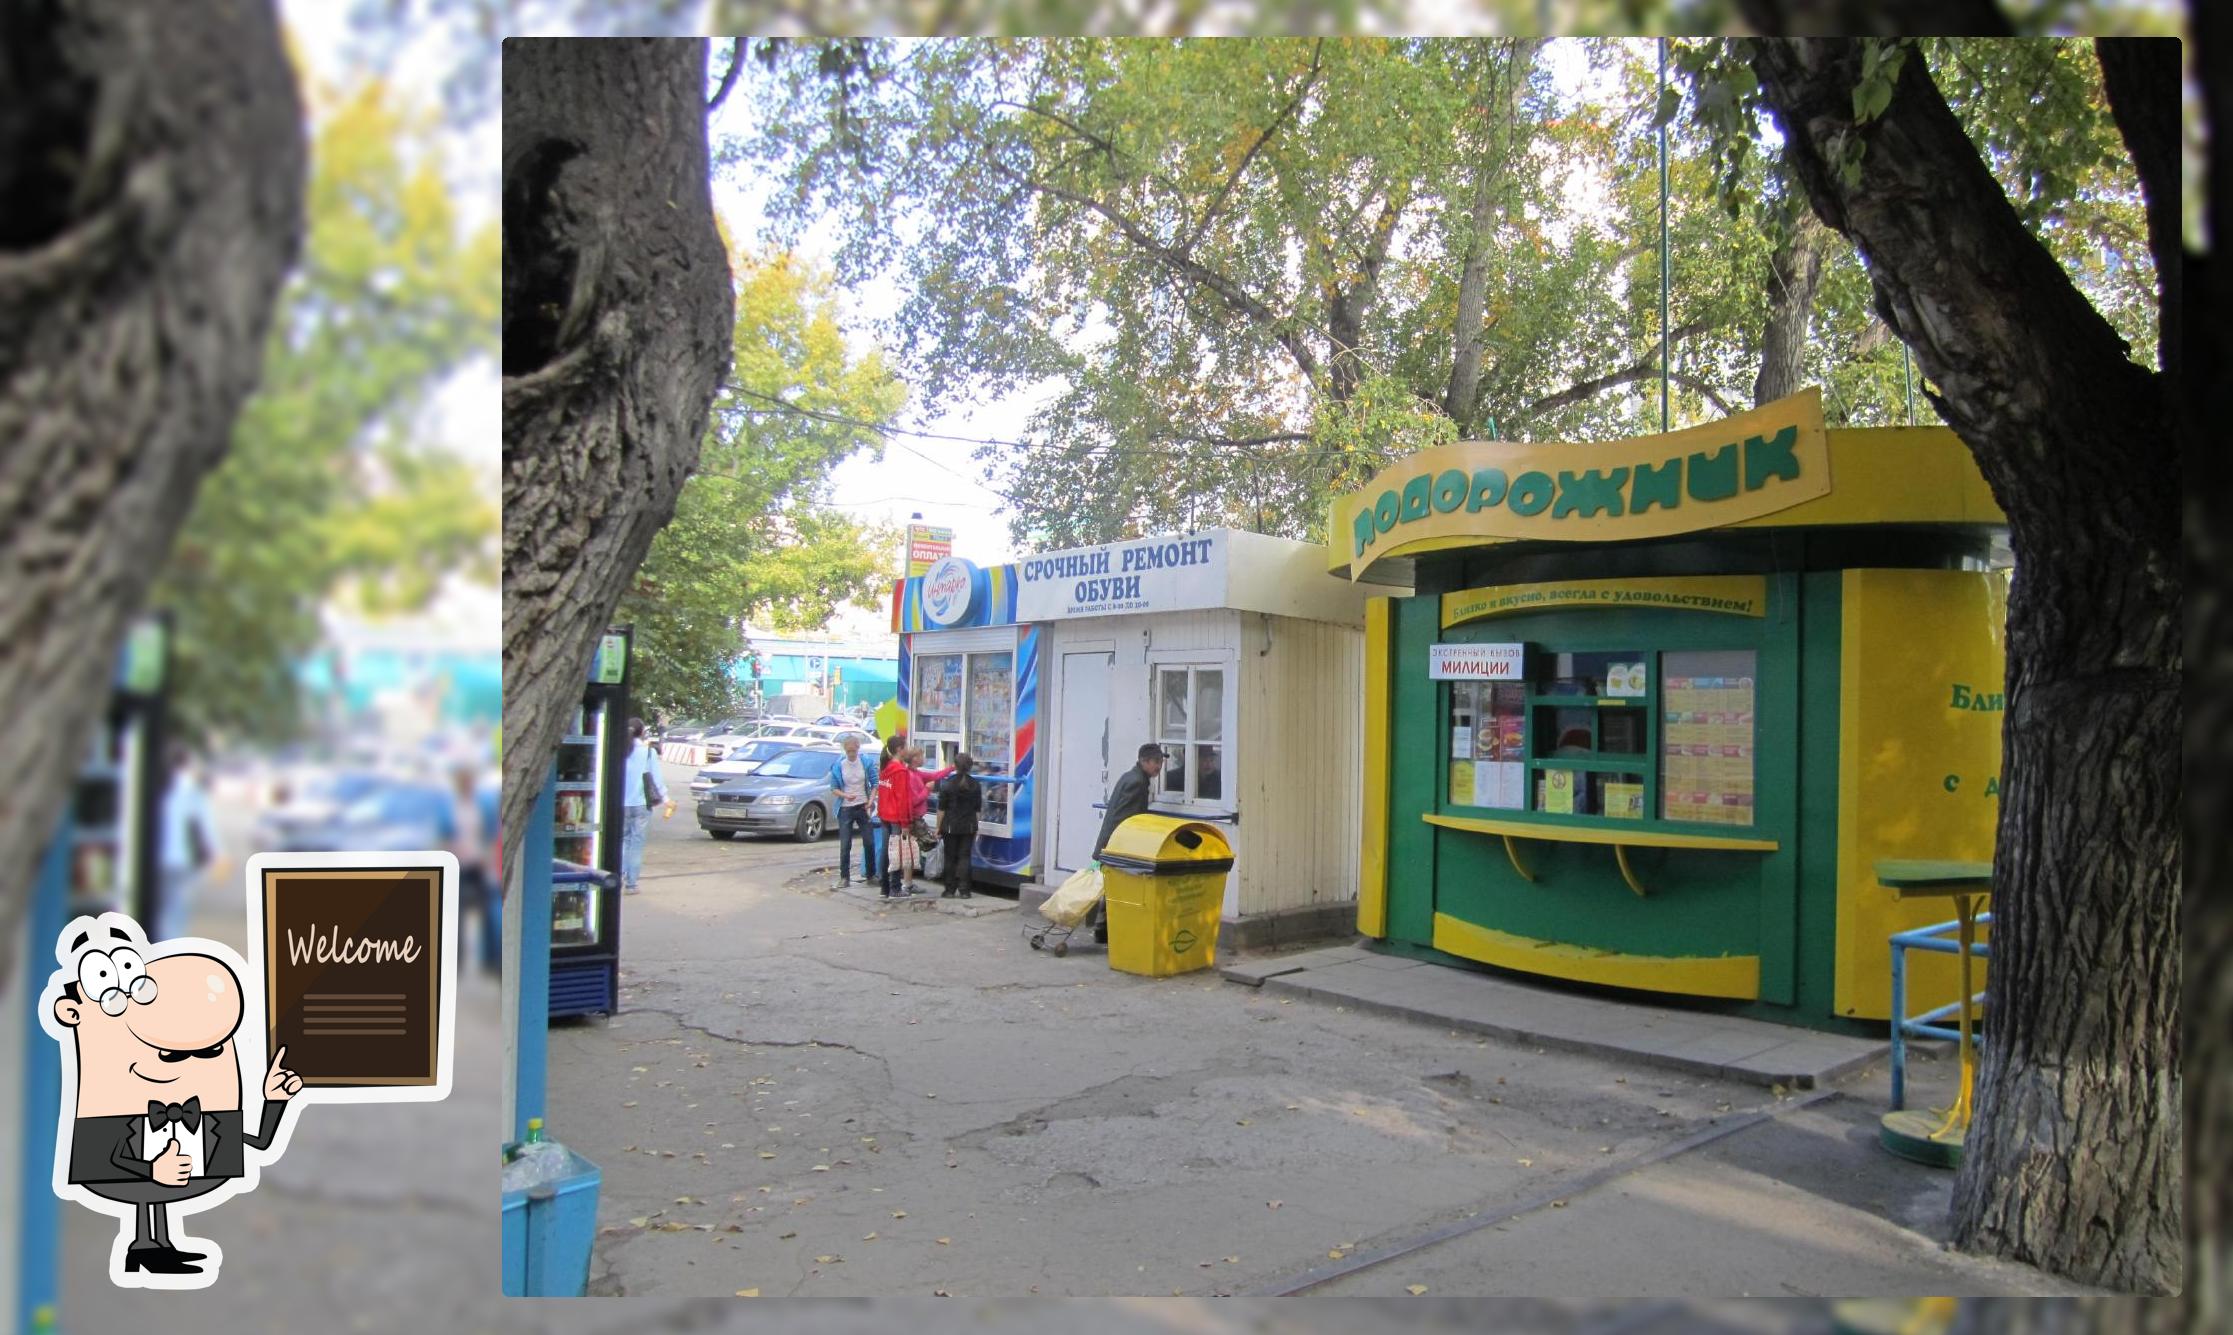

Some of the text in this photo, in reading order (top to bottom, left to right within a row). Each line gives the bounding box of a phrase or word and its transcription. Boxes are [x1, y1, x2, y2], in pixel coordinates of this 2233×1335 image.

[1353, 425, 1800, 559] ПОДОРОЖНИК
[1024, 538, 1213, 582] СРОЧНЫЙ РЕМОНТ
[1075, 575, 1141, 603] ОБУВИ
[1550, 589, 1596, 600] всегда
[1613, 590, 1753, 613] удовольствием!
[1432, 647, 1520, 658] ЭКСТРЕННЫЙ ВЫЗОВ
[1441, 660, 1510, 677] МИЛИЦИИ
[1951, 683, 2005, 711] Бли
